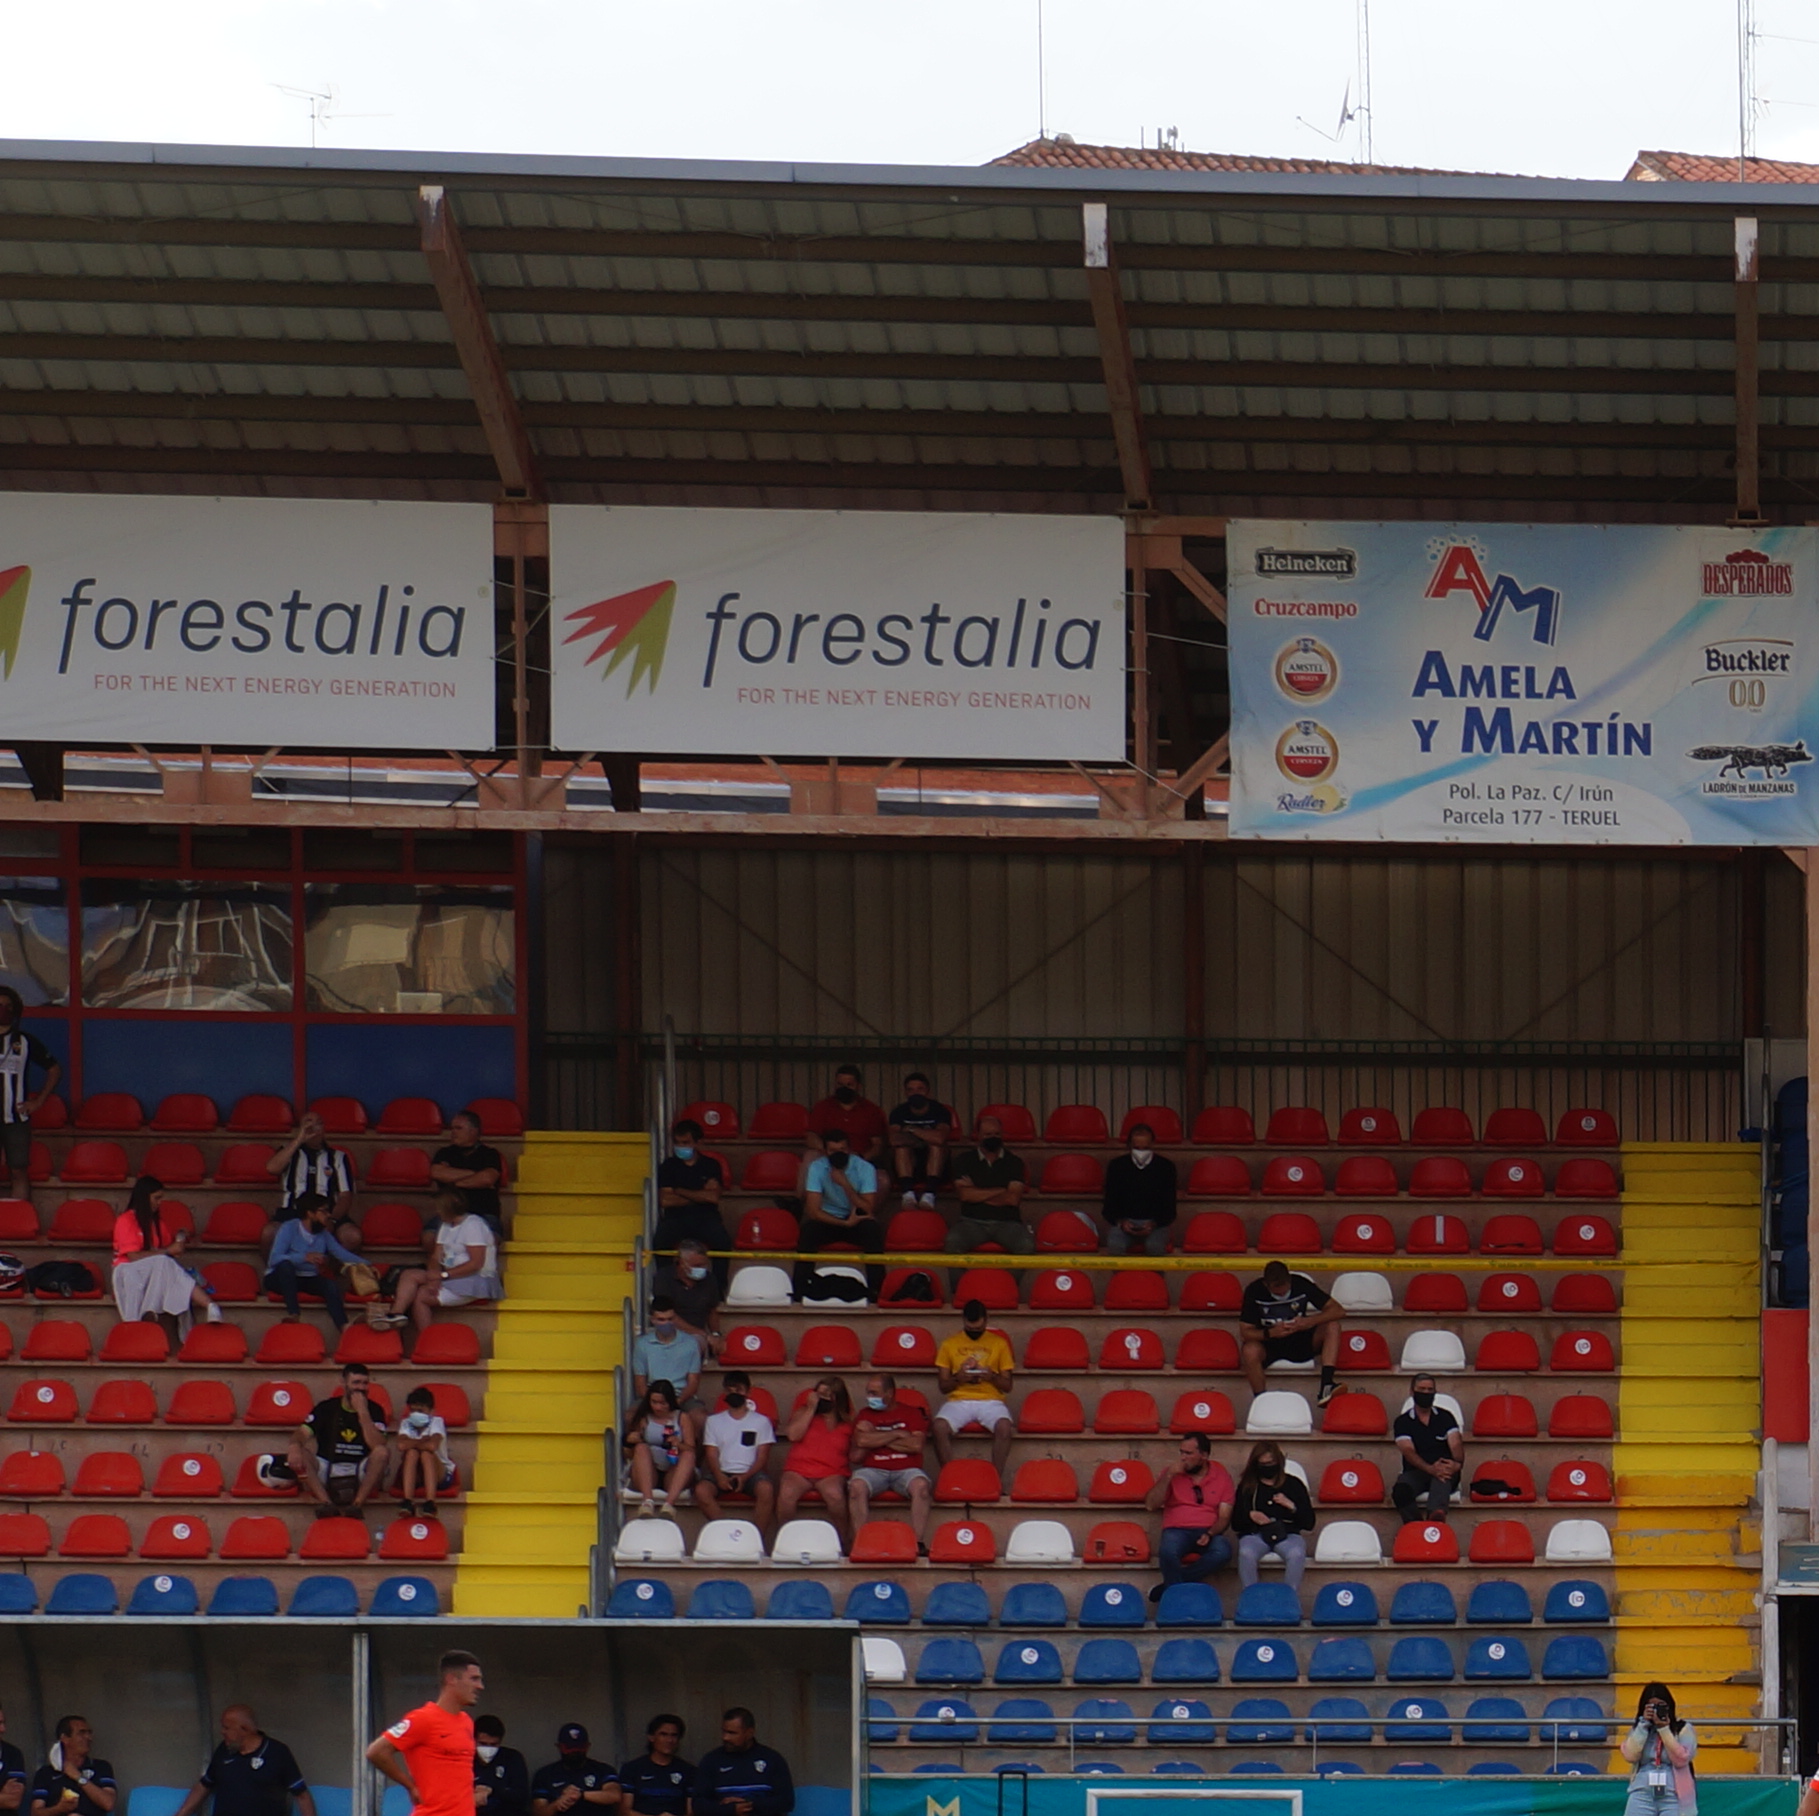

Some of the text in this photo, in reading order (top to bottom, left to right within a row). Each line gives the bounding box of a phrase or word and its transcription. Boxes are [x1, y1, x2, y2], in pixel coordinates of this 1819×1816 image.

[1262, 554, 1348, 572] Heineken
[1703, 563, 1793, 594] DESPERADOS
[1254, 598, 1358, 619] Cruzcampo
[59, 578, 466, 674] forestalia
[703, 593, 1101, 687] forestalia
[1288, 663, 1325, 673] AMSTEL
[1705, 648, 1790, 672] Buckler
[94, 674, 456, 697] FOR THE NEXT ENERGY GENERATION
[737, 688, 1091, 709] FOR THE NEXT ENERGY GENERATION
[1287, 745, 1327, 755] AMSTEL
[1450, 783, 1613, 805] Pol. La Paz. C/ Irún
[1703, 782, 1737, 794] LADRÓN
[1748, 782, 1795, 794] MANZANAS
[1443, 808, 1505, 825] Parcela
[1512, 810, 1543, 825] 177
[1562, 811, 1621, 826] TERUEL
